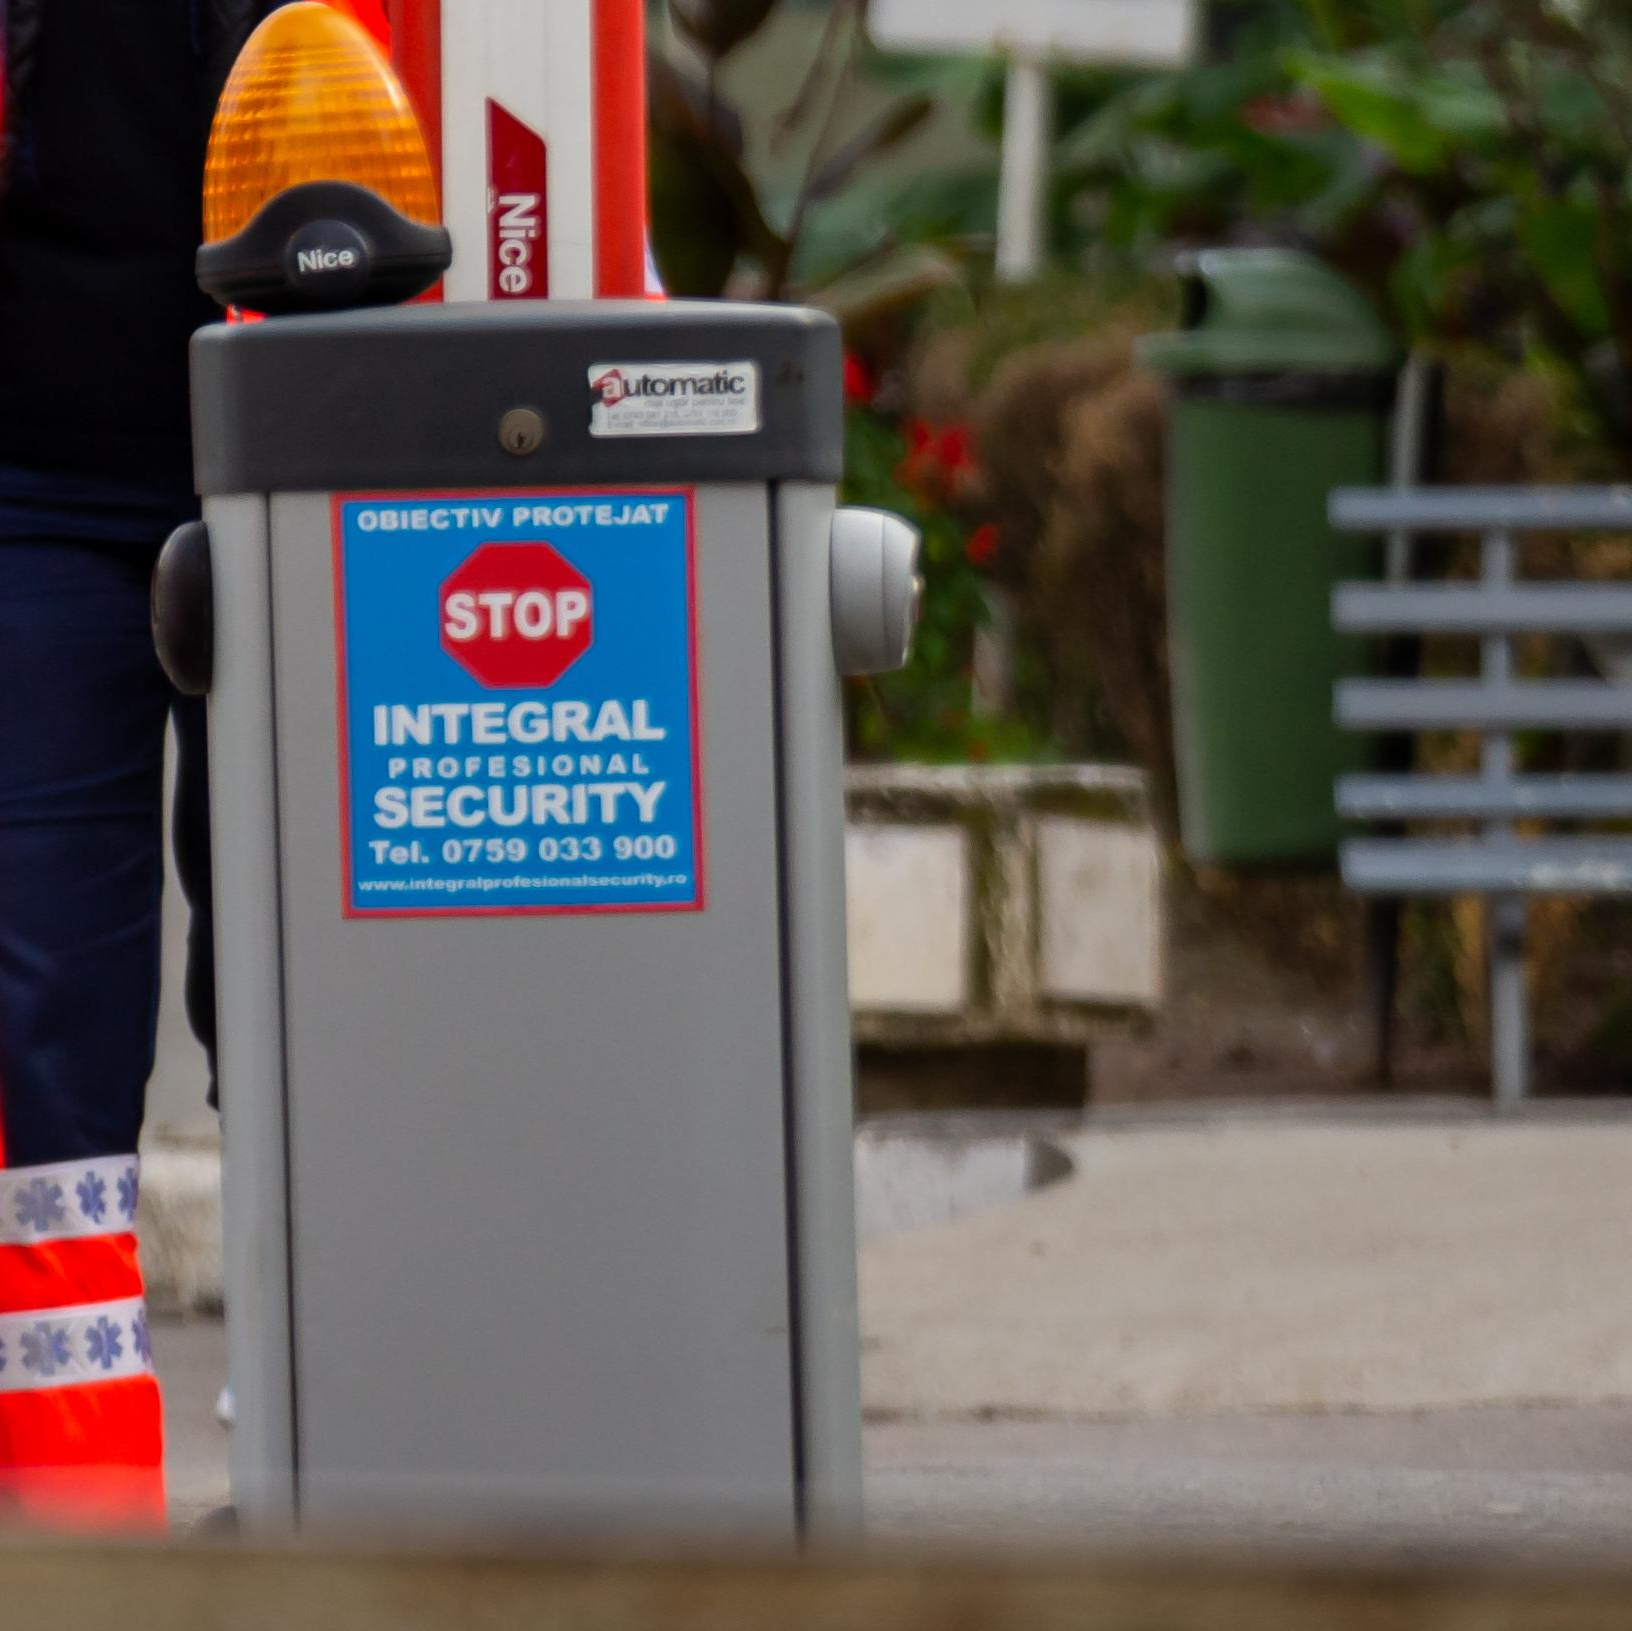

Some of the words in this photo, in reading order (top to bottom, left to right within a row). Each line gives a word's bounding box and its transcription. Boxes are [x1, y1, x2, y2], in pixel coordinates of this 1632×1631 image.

[297, 248, 354, 272] Nice
[498, 195, 538, 294] Nice
[601, 369, 745, 401] automatic
[356, 507, 503, 531] OBIECTIV
[512, 504, 669, 526] PROTEJAT
[444, 591, 587, 640] STOP
[373, 699, 666, 746] INTEGRAL
[388, 753, 650, 779] PROFESIONAL
[373, 781, 666, 828] SECURITY
[368, 839, 429, 864] Tel.
[442, 838, 527, 863] 0759
[538, 836, 602, 861] 033
[613, 834, 676, 860] 900
[358, 873, 687, 892] www.integralprofesionalsecurity.ro
